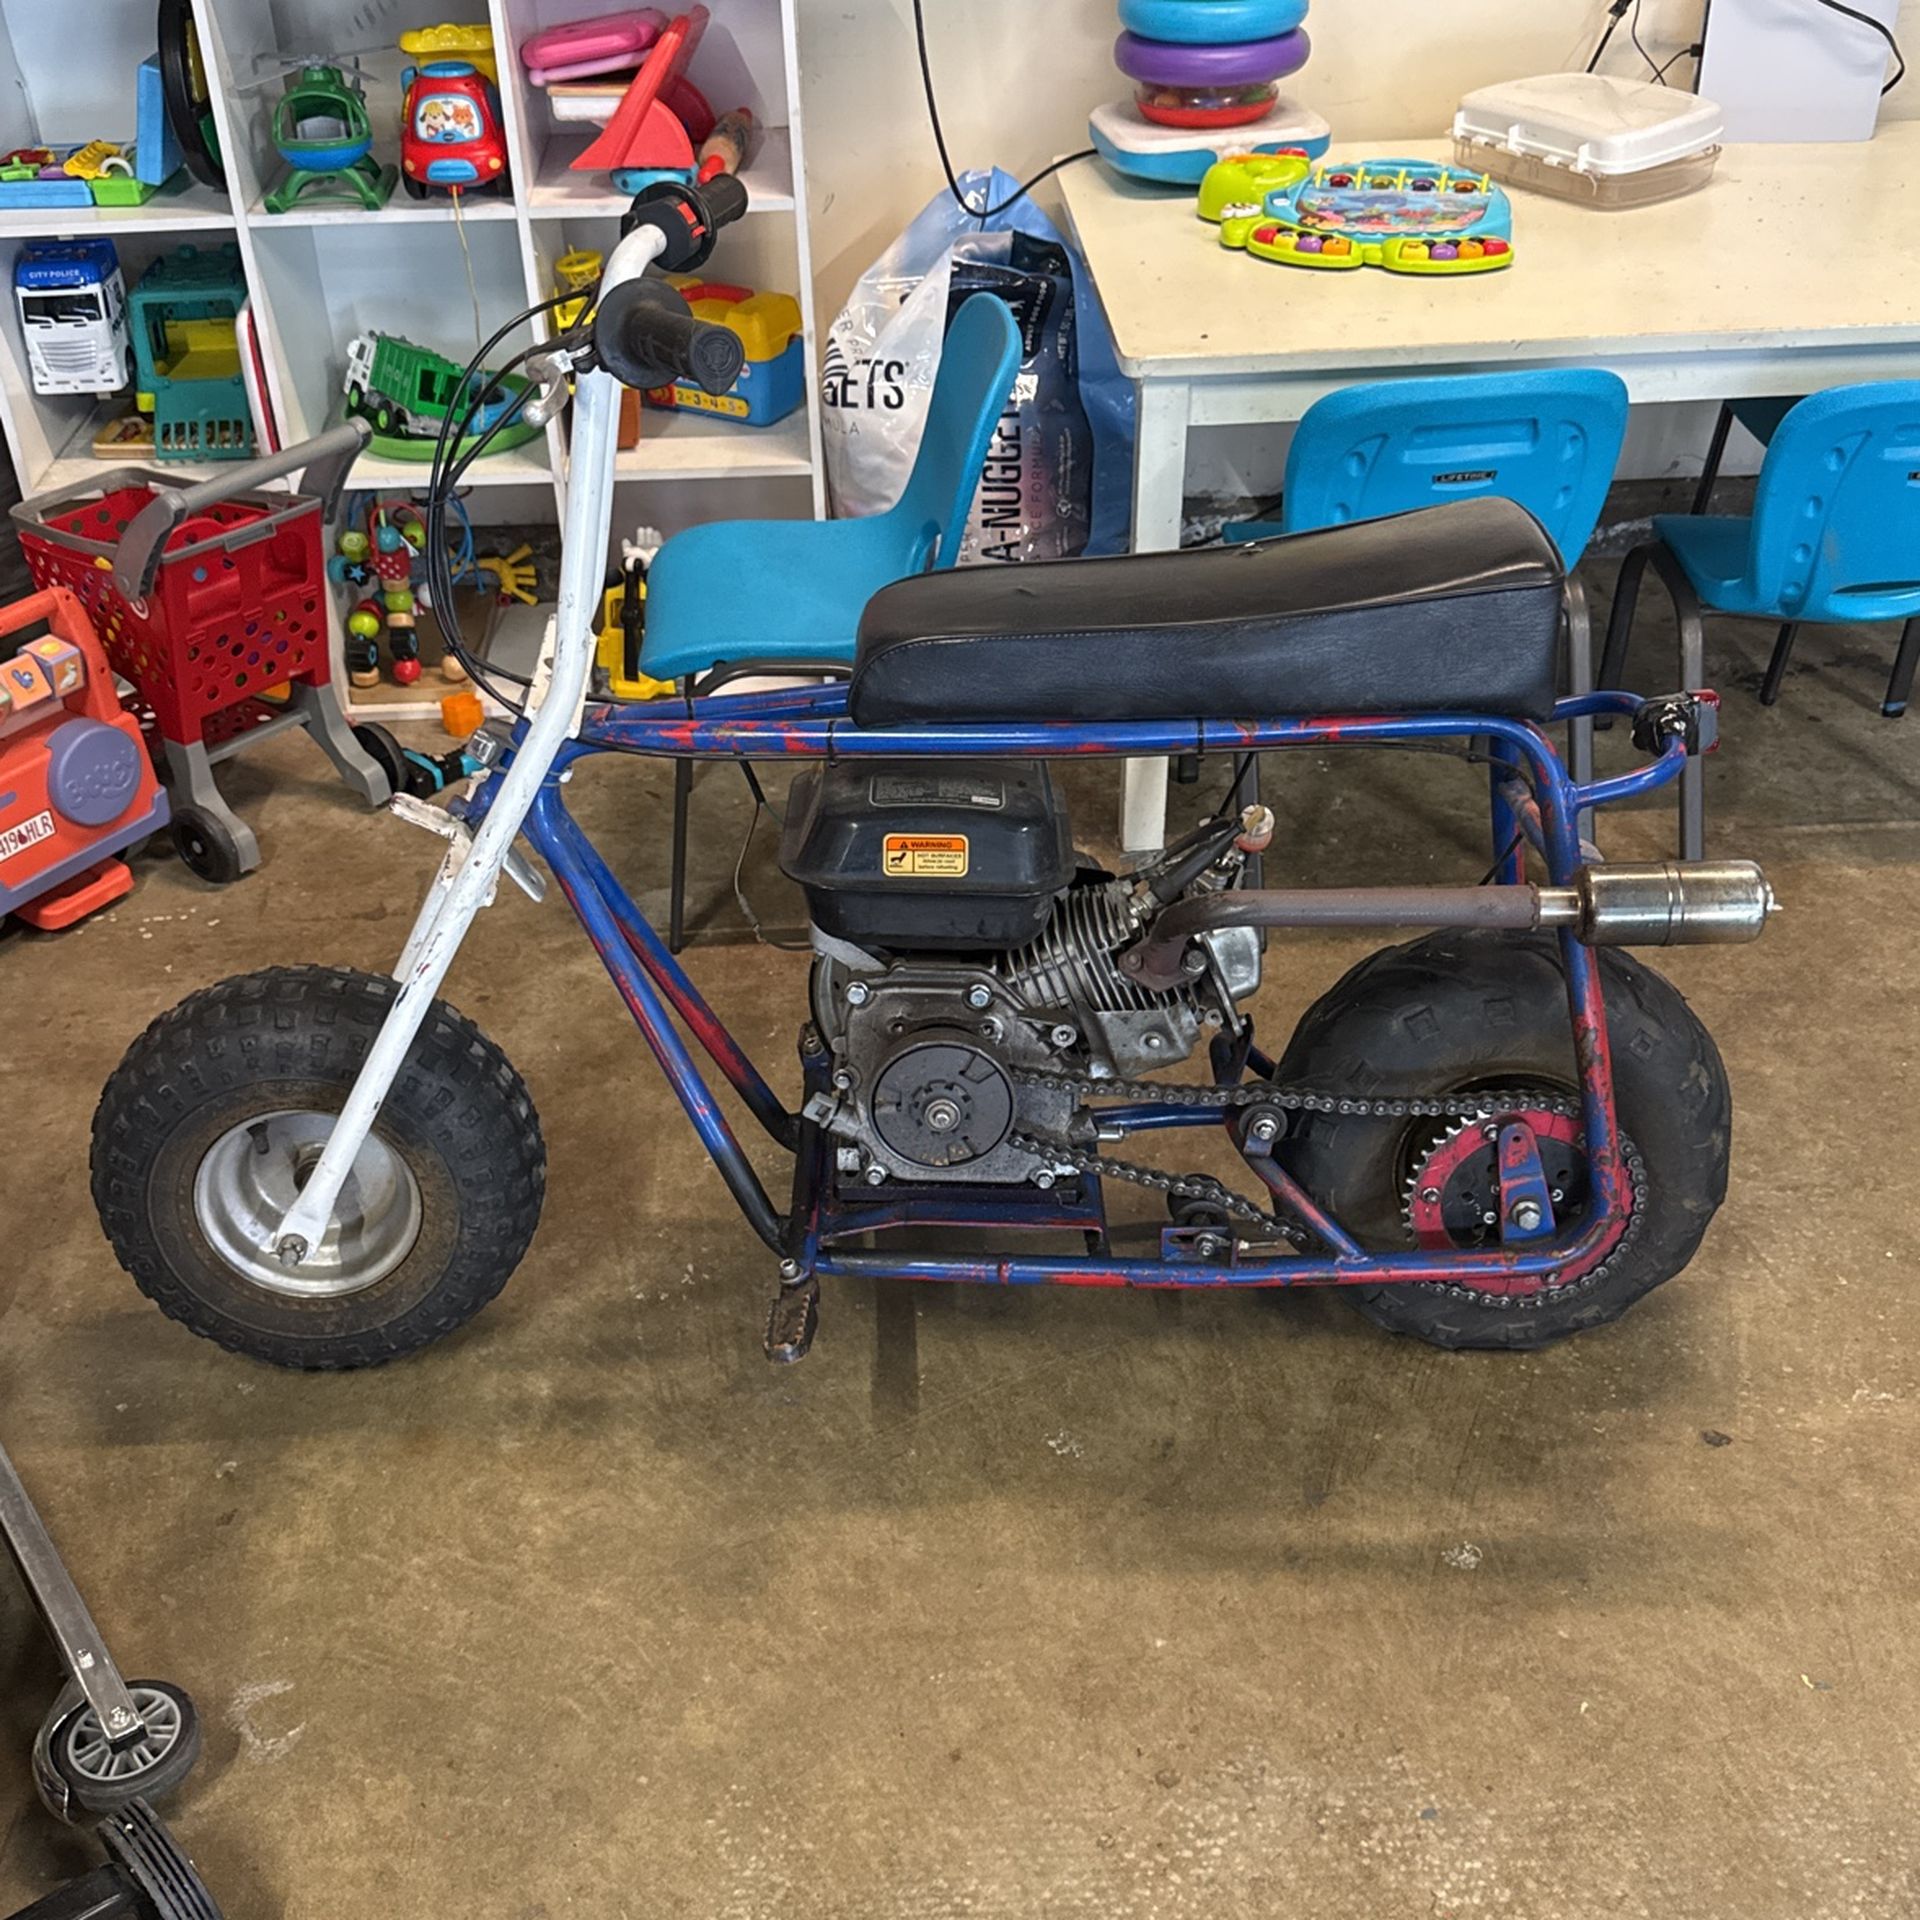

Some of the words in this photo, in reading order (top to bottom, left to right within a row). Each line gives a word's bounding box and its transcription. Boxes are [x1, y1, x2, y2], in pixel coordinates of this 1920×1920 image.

[28, 271, 48, 279] CITY
[49, 269, 80, 278] POLICE
[694, 393, 701, 405] 3
[711, 397, 718, 408] 4
[1441, 472, 1486, 481] LIFETIME
[24, 815, 53, 842] HLR
